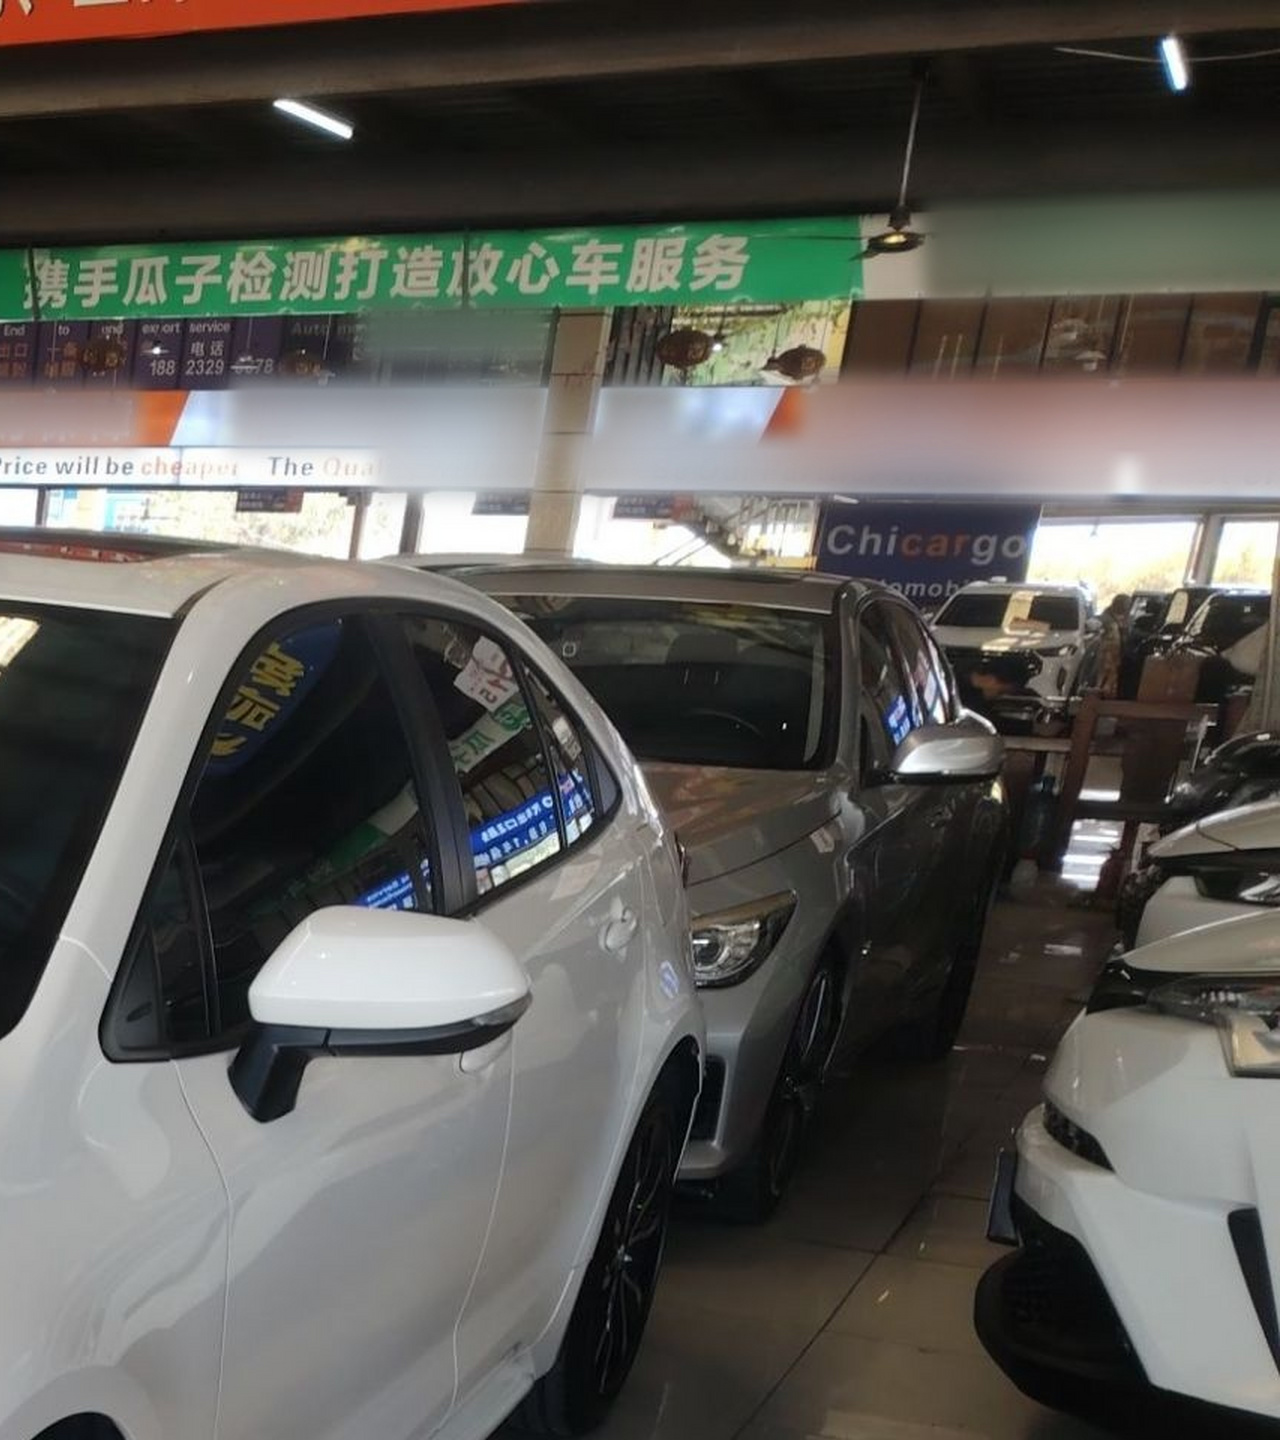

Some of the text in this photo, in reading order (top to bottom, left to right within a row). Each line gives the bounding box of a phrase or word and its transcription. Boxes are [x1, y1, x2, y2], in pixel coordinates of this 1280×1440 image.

[21, 234, 751, 308] 携手瓜子检测打造放心车服务
[57, 324, 71, 337] to
[149, 359, 177, 376] 188
[184, 359, 225, 376] 2329
[55, 454, 100, 476] will
[105, 455, 135, 476] be
[267, 455, 315, 478] The
[826, 522, 1028, 566] Chicargo
